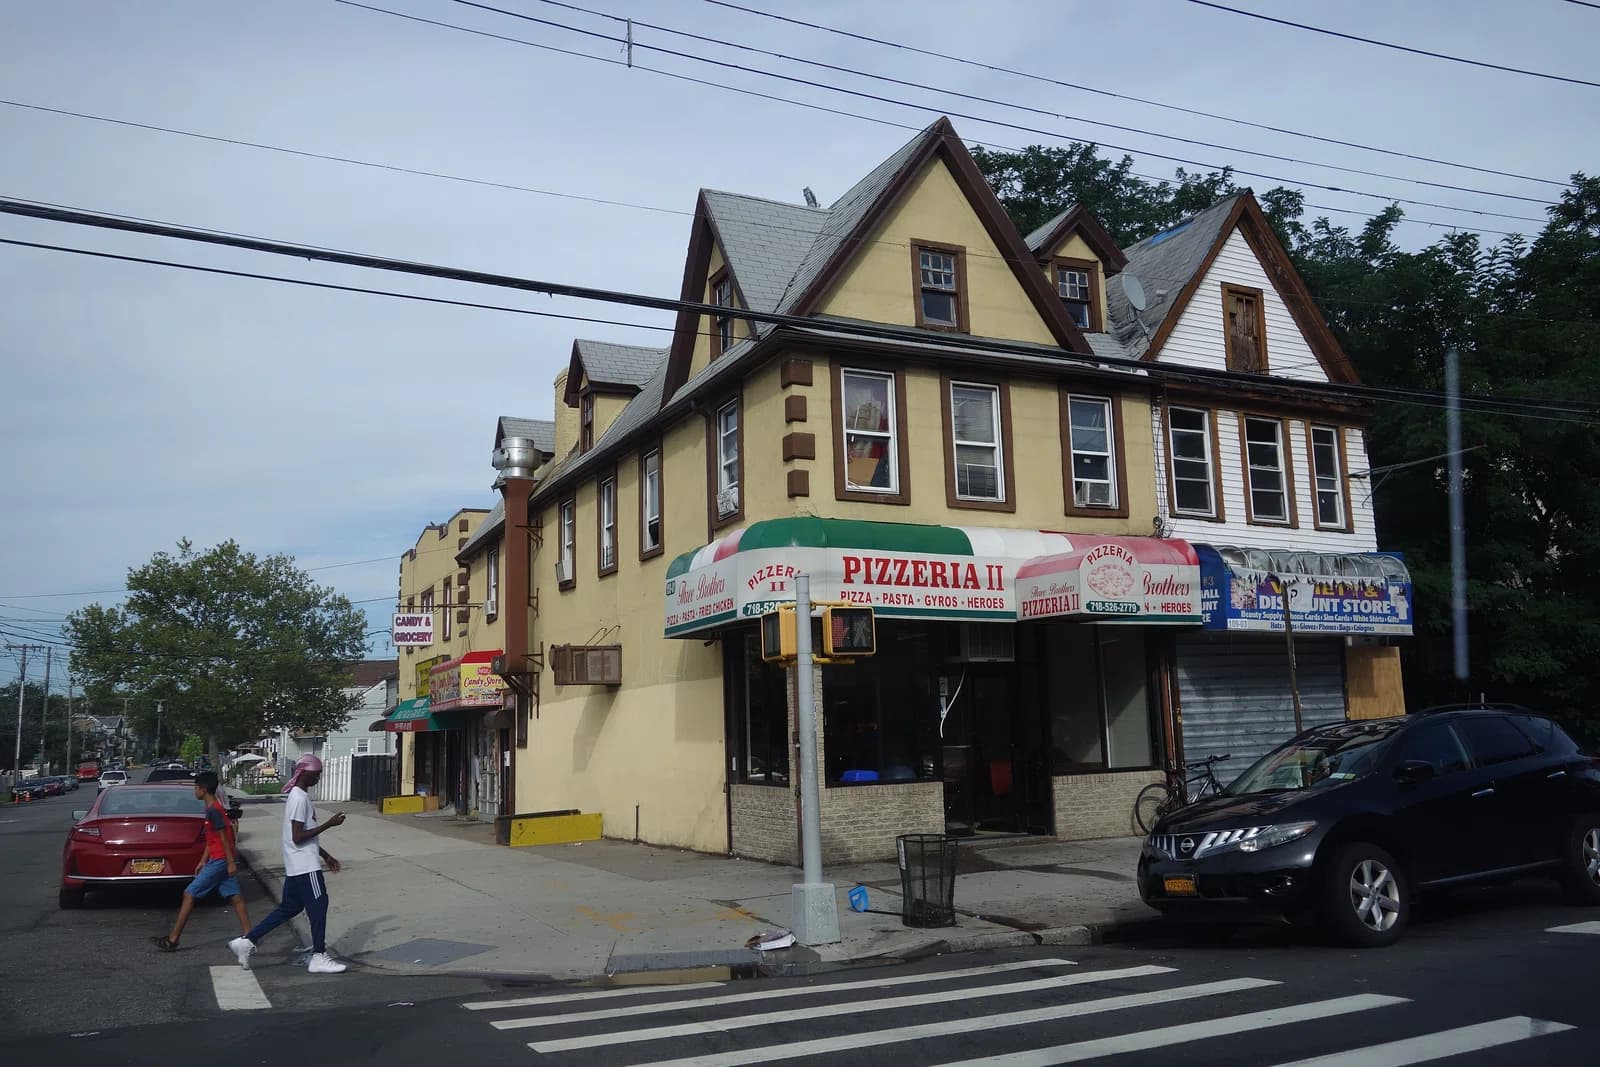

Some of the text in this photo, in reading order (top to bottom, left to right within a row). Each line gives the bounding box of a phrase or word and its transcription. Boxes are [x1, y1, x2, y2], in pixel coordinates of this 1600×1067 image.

[1087, 545, 1133, 566] PIZZERIA
[747, 565, 801, 591] PIZZER
[842, 556, 1005, 591] PIZZERIA II
[1143, 569, 1190, 596] Brothers
[696, 571, 725, 600] Brothers
[769, 581, 786, 592] II
[1048, 582, 1075, 596] Brothers
[699, 604, 712, 617] FRIED
[713, 598, 734, 613] CHICKEN
[840, 591, 1005, 609] PIZZA PASTA GYROS HEROES
[1022, 593, 1080, 617] PIZZERIA II
[1161, 602, 1192, 613] HEROES
[1259, 595, 1391, 615] DISUNT STORE
[395, 616, 431, 627] CANDY &
[1241, 609, 1262, 620] Beauty
[1262, 611, 1283, 620] Supply
[1304, 613, 1320, 621] Cards
[395, 632, 432, 642] GROCERY
[464, 677, 483, 688] Candy
[483, 676, 502, 688] Store
